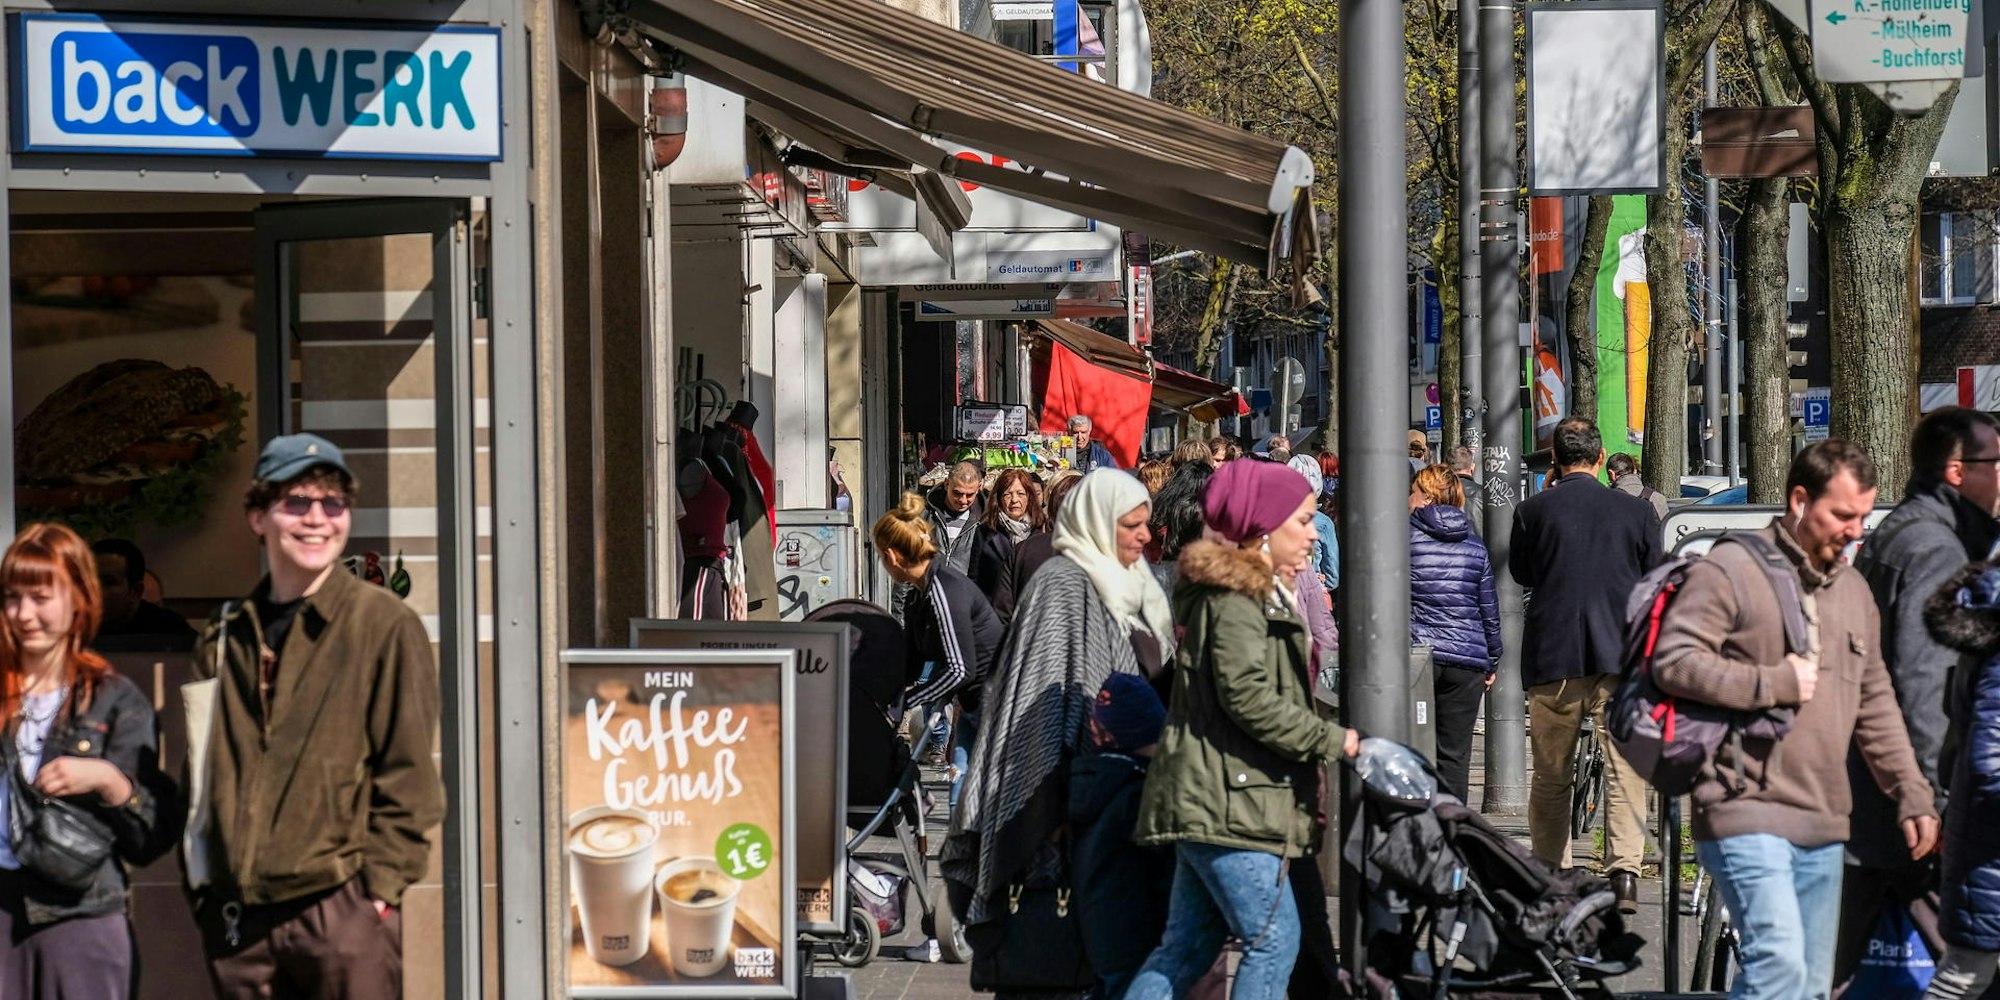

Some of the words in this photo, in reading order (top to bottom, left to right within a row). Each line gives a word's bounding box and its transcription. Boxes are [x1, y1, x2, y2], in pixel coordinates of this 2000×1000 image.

[1872, 48, 1963, 68] -Buchforst
[62, 40, 252, 128] back
[273, 45, 476, 131] WERK
[999, 265, 1063, 274] Geldautomat
[645, 672, 693, 688] MEIN
[604, 748, 743, 811] Genuß
[737, 951, 771, 963] back
[735, 966, 775, 978] WERK
